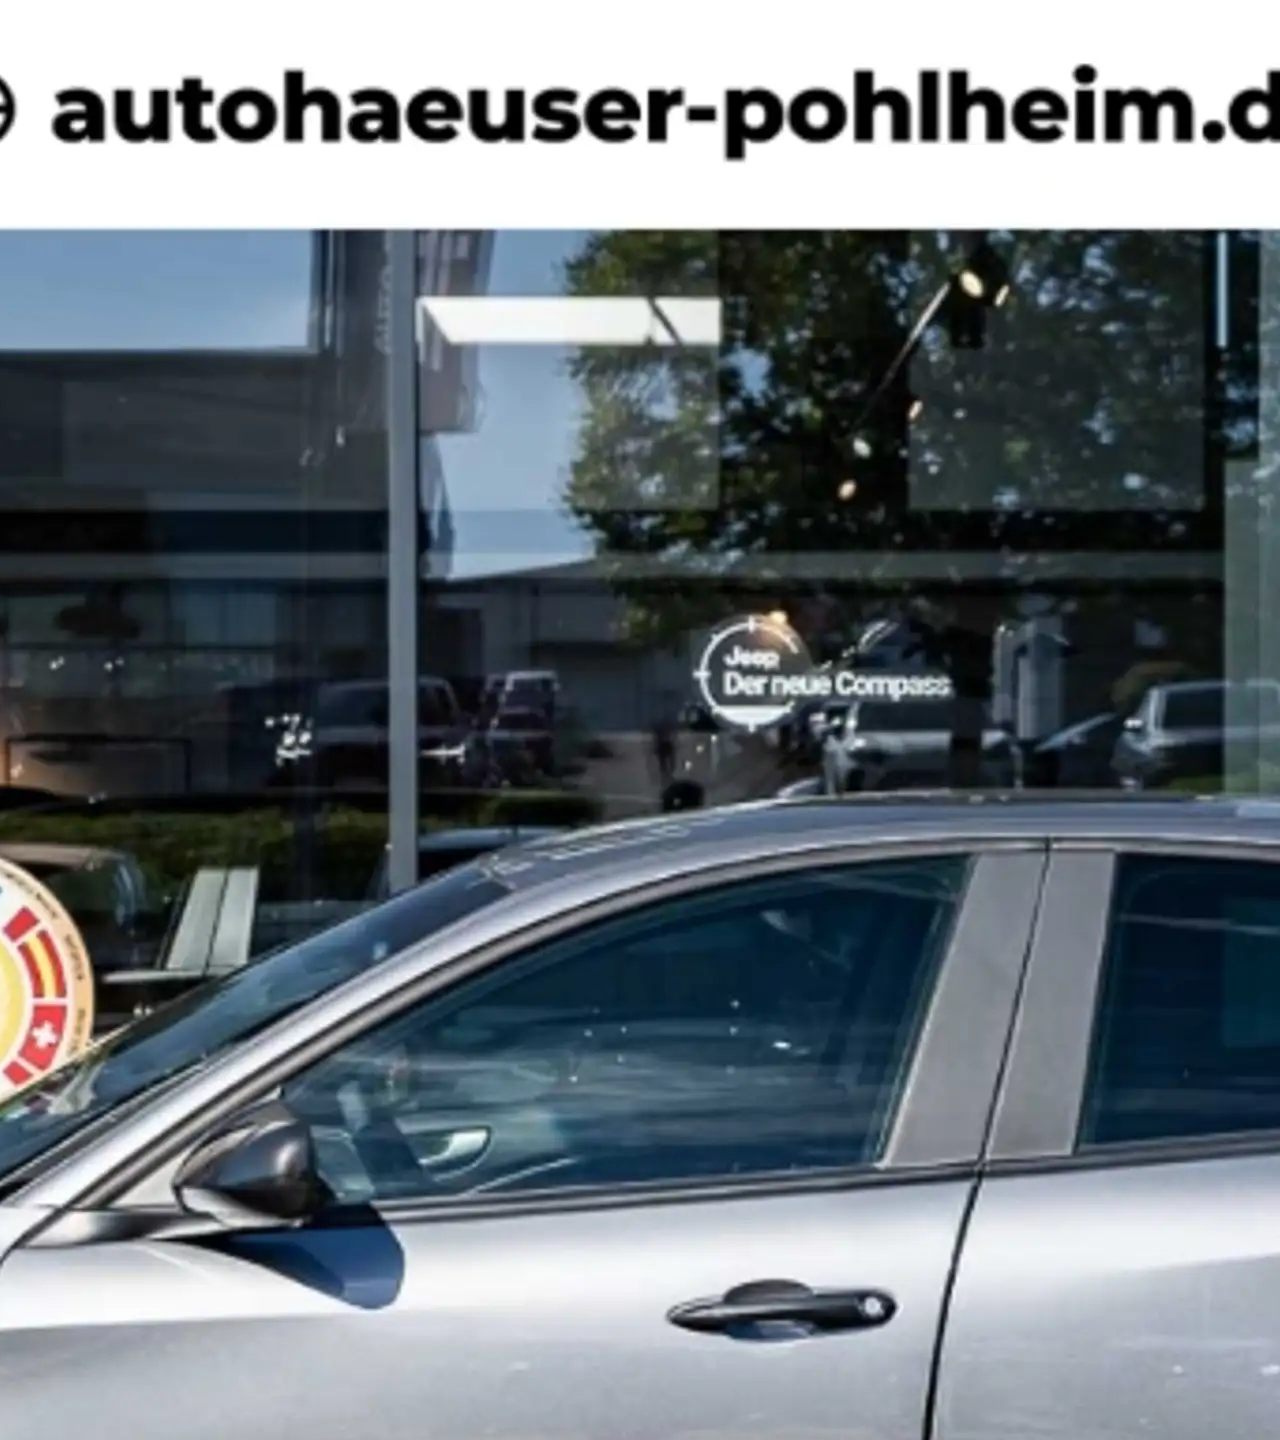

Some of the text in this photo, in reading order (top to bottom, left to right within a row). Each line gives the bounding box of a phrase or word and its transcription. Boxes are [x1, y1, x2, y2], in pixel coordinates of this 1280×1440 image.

[723, 645, 781, 670] Jeep
[724, 671, 953, 701] Der neue Compass
